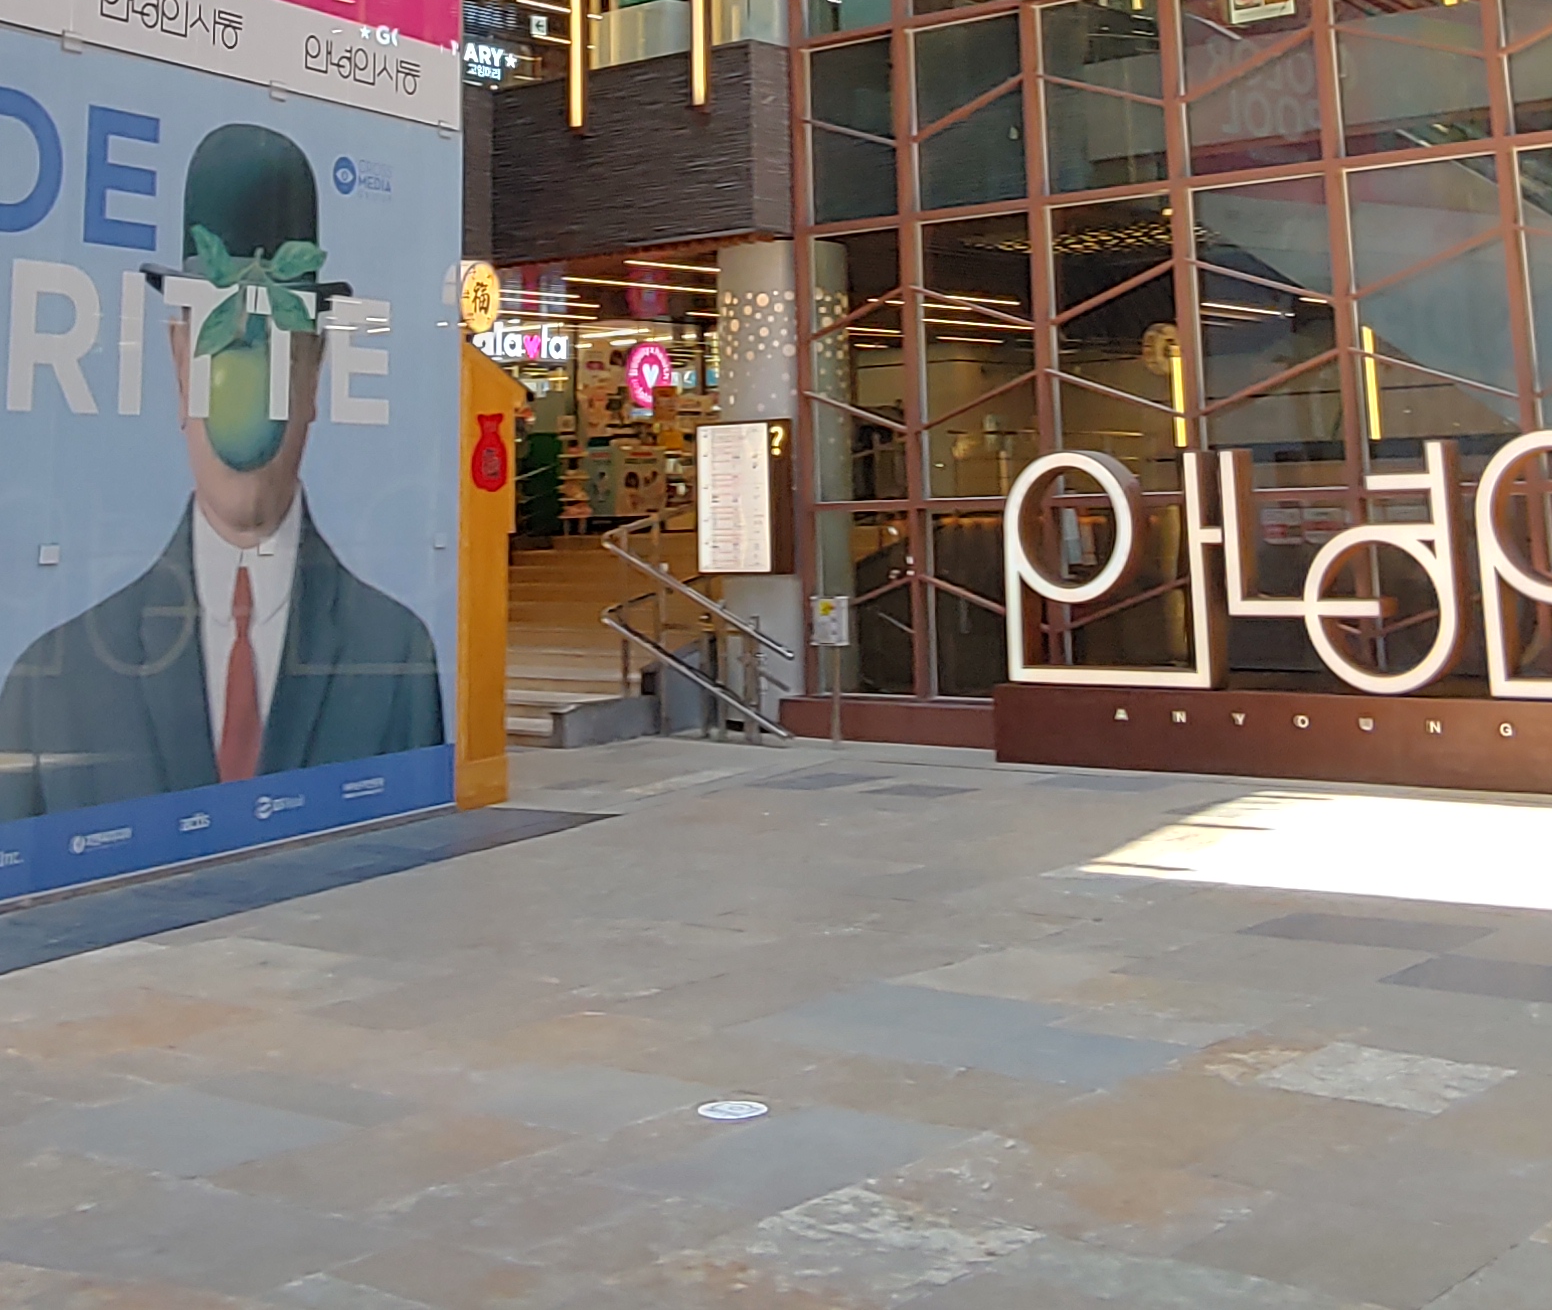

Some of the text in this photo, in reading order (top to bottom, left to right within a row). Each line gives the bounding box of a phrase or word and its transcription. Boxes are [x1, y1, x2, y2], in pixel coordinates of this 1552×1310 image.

[304, 34, 422, 96] 안녕인사동
[471, 282, 491, 316] 福
[1115, 708, 1515, 738] ANYOUNG
